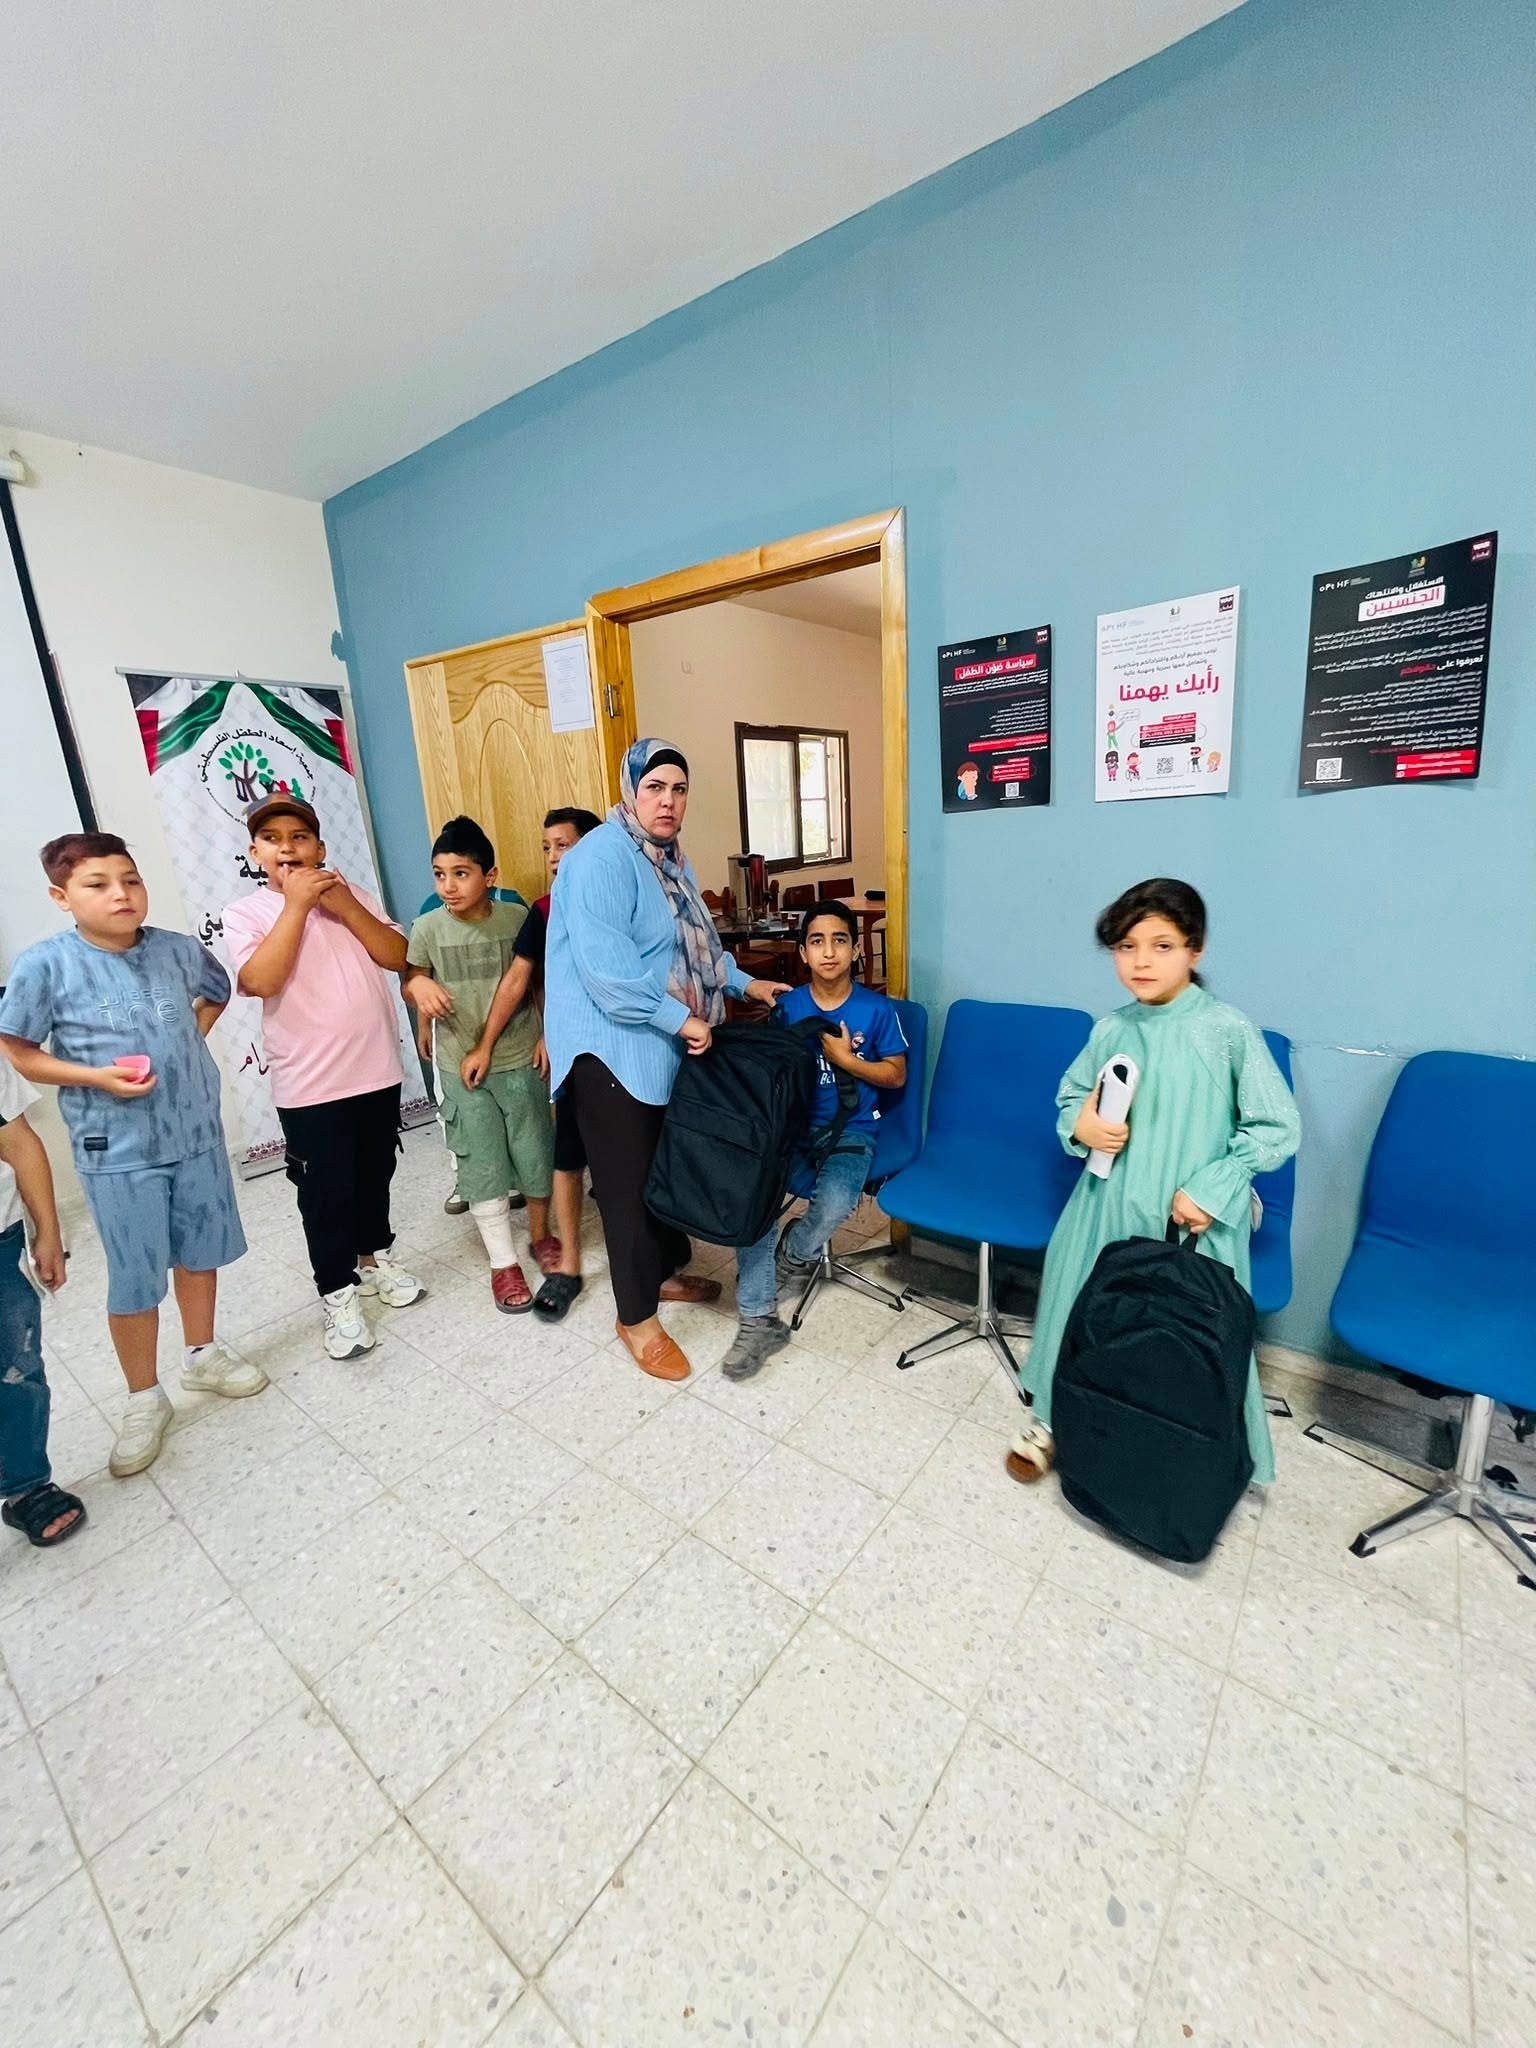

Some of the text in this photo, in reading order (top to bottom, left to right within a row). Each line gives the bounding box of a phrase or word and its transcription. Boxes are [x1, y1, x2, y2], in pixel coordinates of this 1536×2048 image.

[1319, 582, 1334, 592] oPt
[1336, 578, 1350, 588] HF
[1365, 576, 1444, 600] الاستغلال والانتهاك
[1366, 587, 1440, 617] الجنسيين
[1005, 657, 1034, 671] سياسة
[1436, 660, 1455, 671] على
[1456, 654, 1484, 668] تعرفوا
[959, 665, 984, 680] الطفل
[1119, 664, 1219, 702] رأيك يهمنا
[232, 728, 267, 739] الطفل
[268, 735, 297, 755] إسعاد
